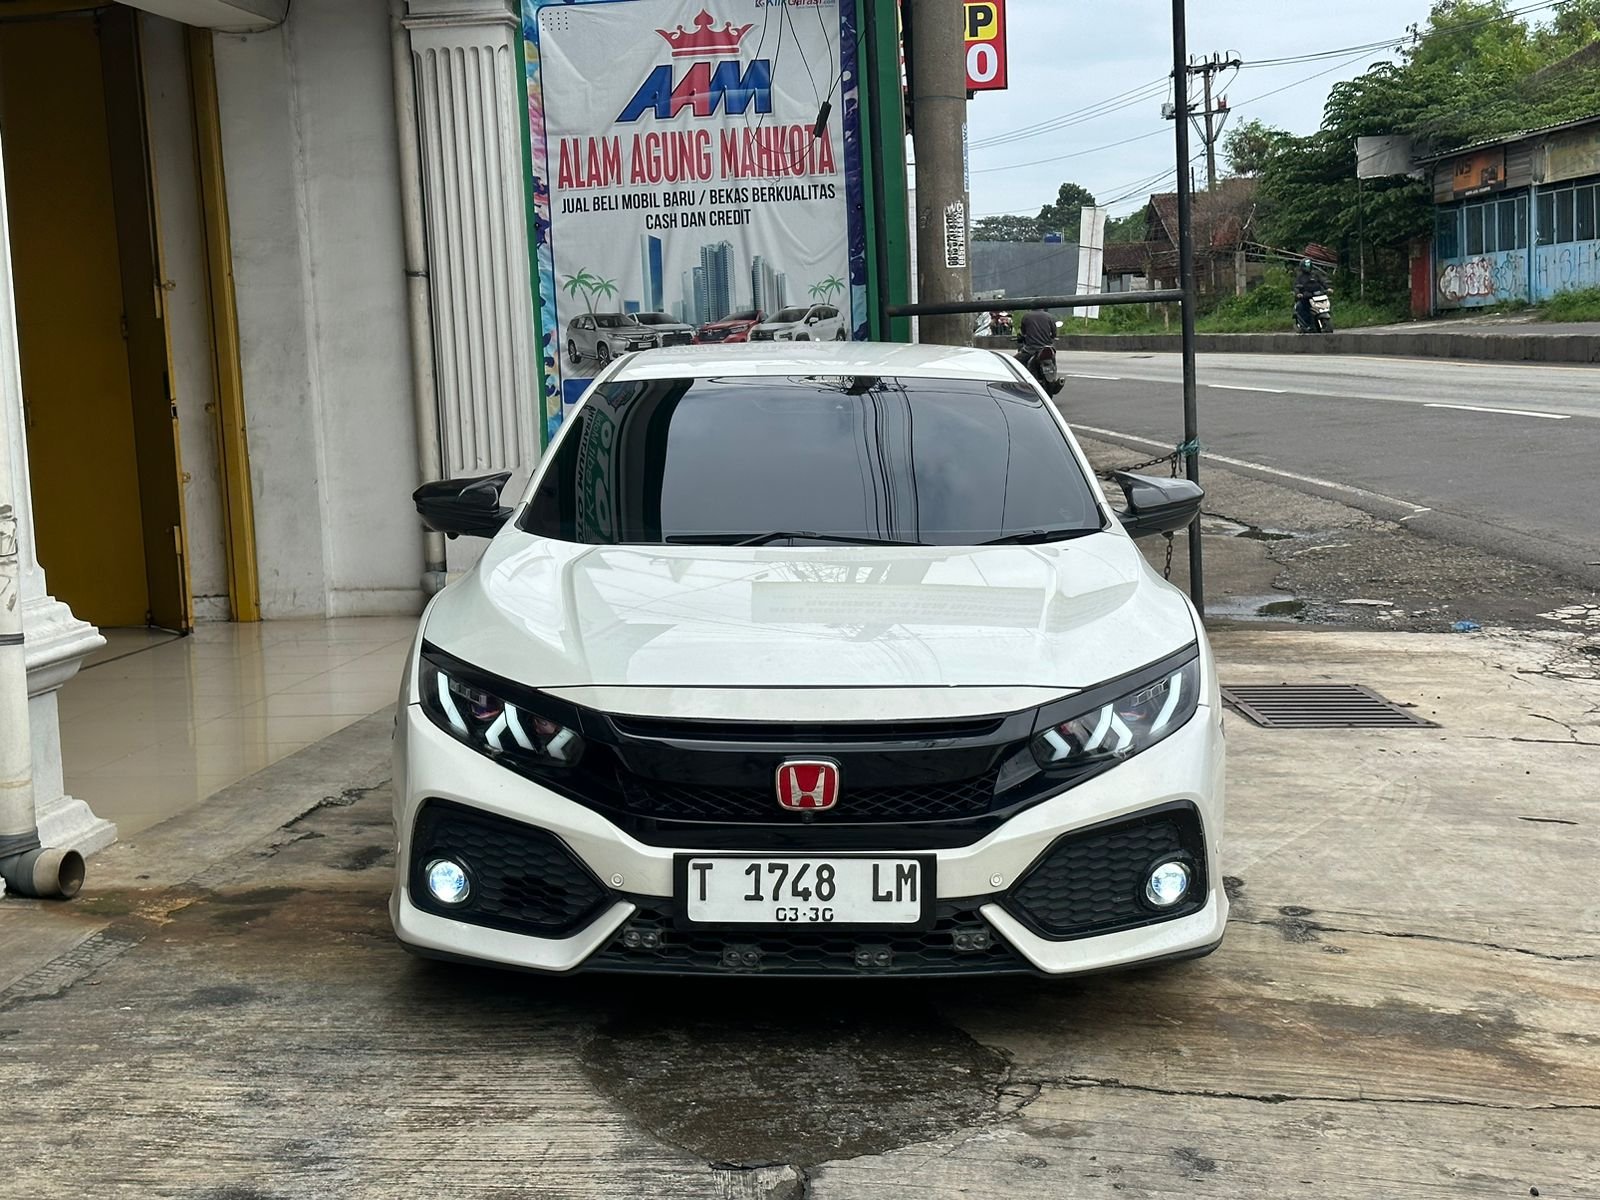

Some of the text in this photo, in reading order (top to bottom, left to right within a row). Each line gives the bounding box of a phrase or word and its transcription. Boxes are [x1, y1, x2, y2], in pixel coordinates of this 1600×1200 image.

[964, 5, 993, 37] P
[615, 58, 772, 123] AAM
[557, 123, 835, 190] ALAM AGUNG MAHKOTA
[561, 197, 590, 215] JUAL
[593, 194, 619, 212] BELI
[622, 192, 660, 210] MOBIL
[663, 190, 696, 207] BARU
[709, 189, 749, 205] BEKAS
[752, 183, 836, 203] BERKUALITAS
[645, 209, 752, 230] CASH DAN CREDIT
[692, 862, 917, 902] T 1748 LM
